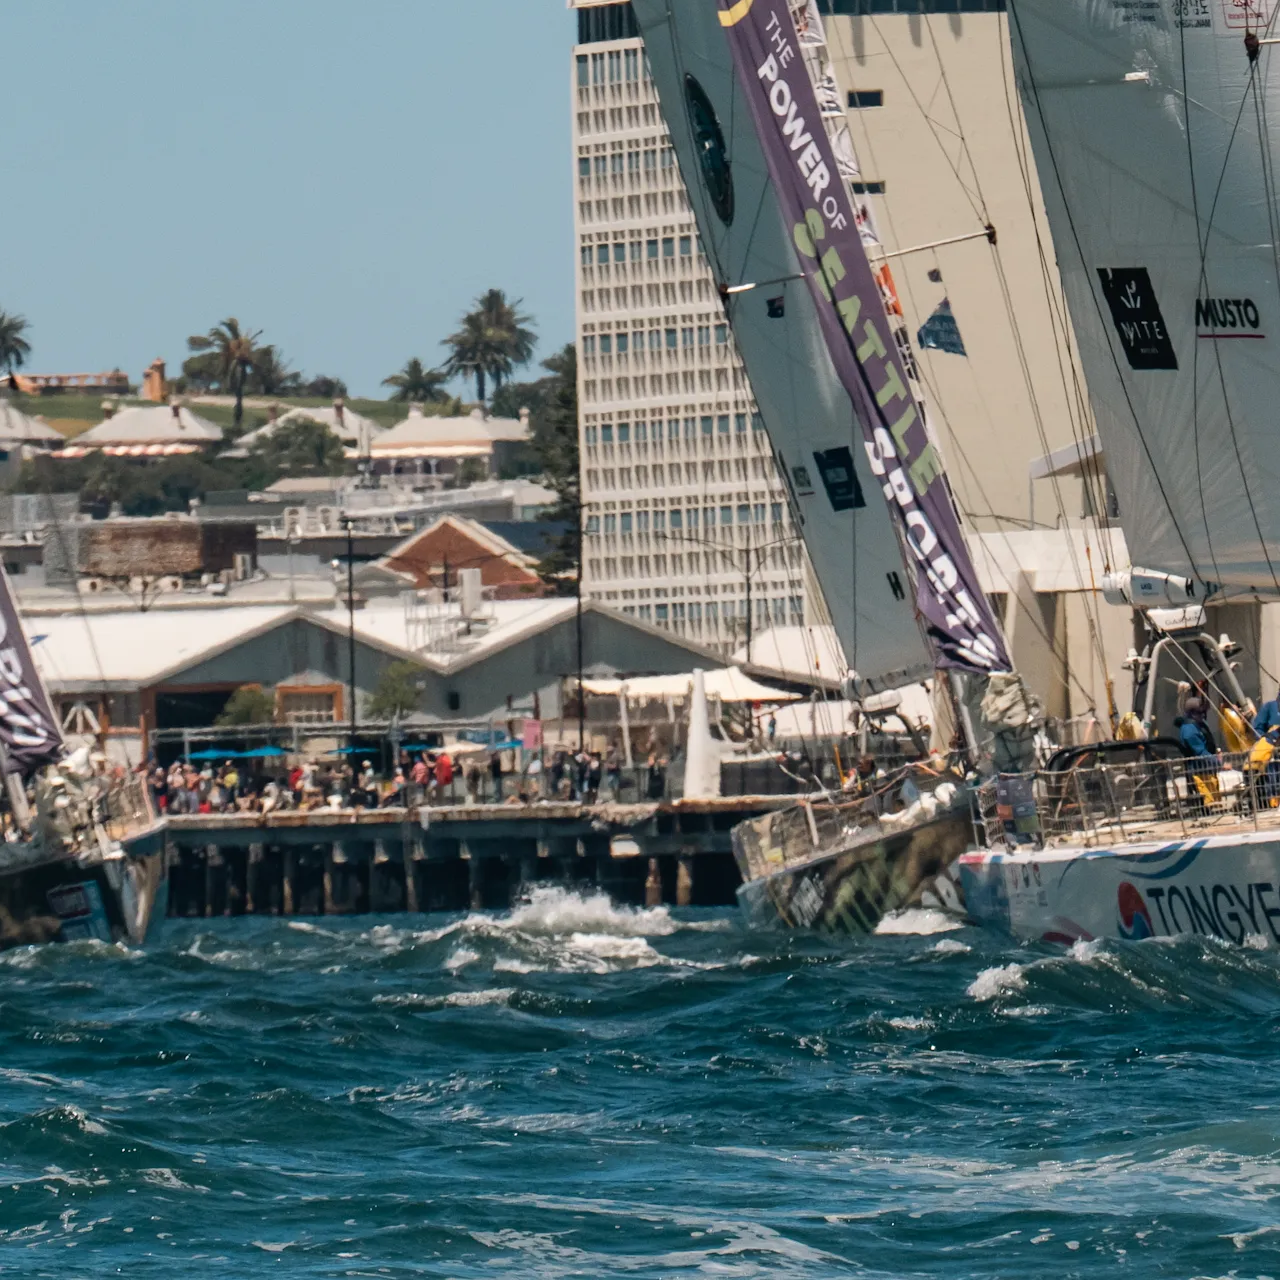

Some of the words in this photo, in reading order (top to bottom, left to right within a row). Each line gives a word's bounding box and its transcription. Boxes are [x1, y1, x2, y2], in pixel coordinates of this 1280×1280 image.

[765, 10, 795, 69] THE
[756, 53, 831, 203] POWER
[822, 196, 848, 231] OF
[1195, 298, 1259, 329] MUSTO
[793, 207, 944, 497] SEATTLE
